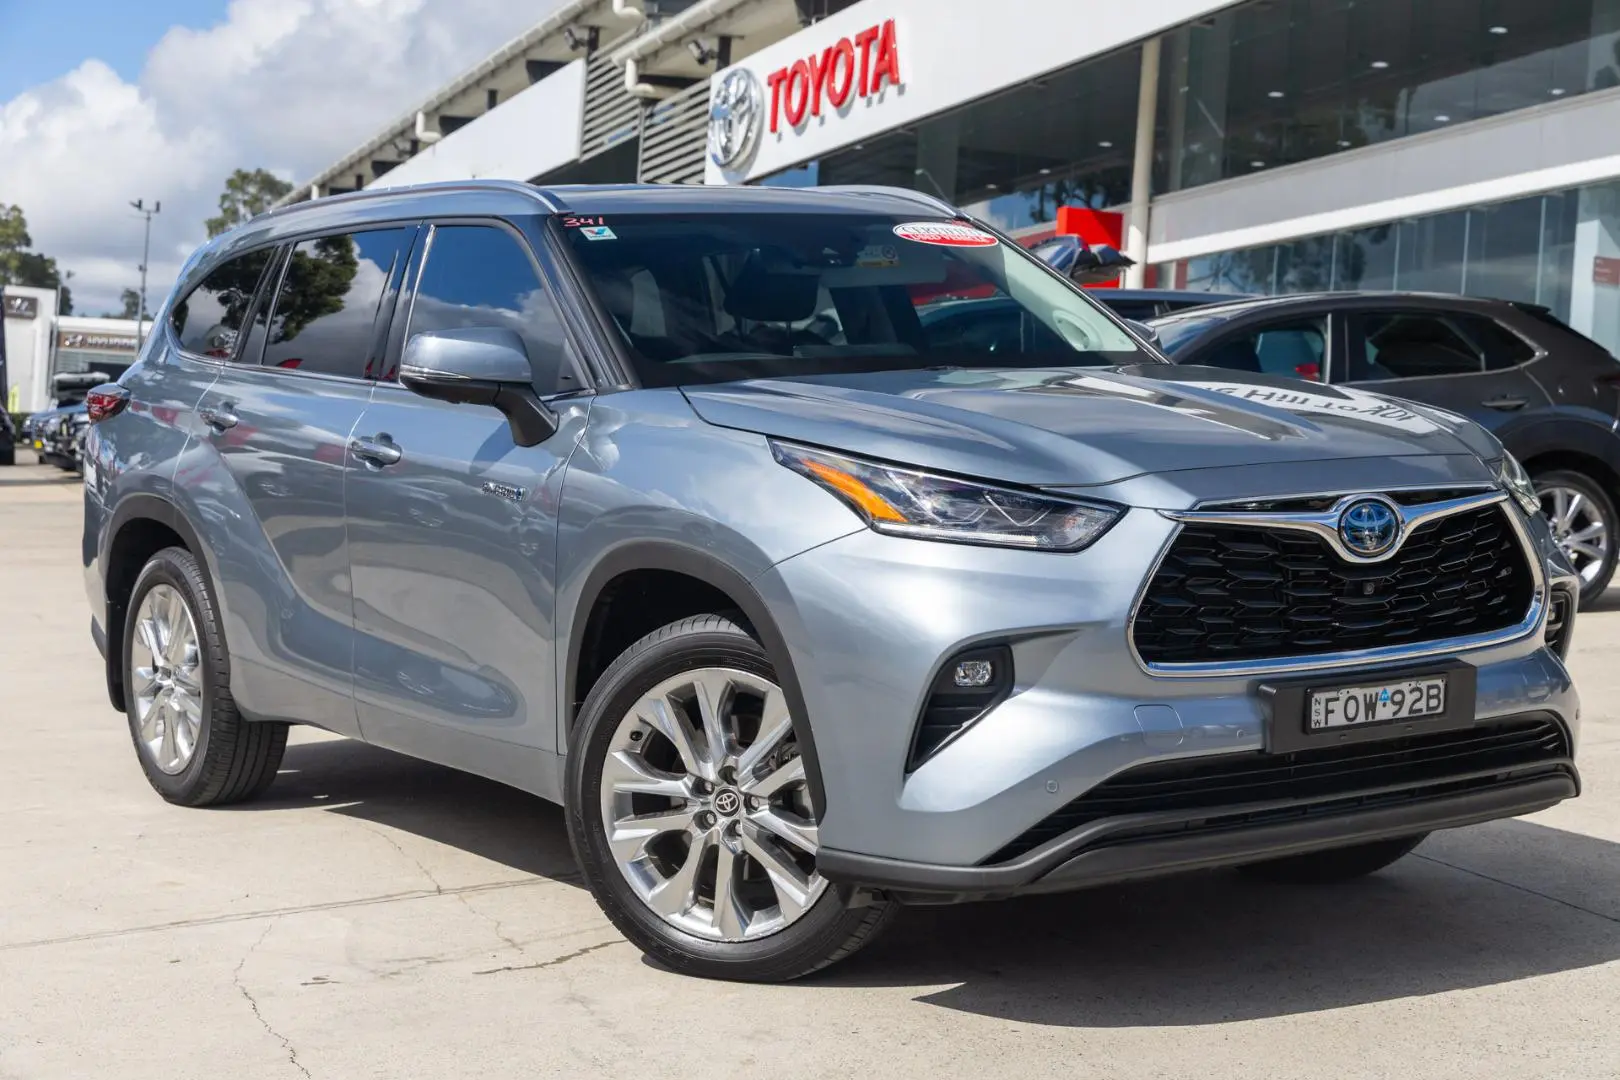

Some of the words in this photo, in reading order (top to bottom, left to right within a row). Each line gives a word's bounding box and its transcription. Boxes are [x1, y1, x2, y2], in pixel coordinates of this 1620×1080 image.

[767, 17, 900, 134] TOYOTA
[563, 215, 605, 227] 341
[1313, 697, 1321, 727] NSW
[1324, 691, 1379, 726] FOW
[1390, 684, 1442, 717] 92B
